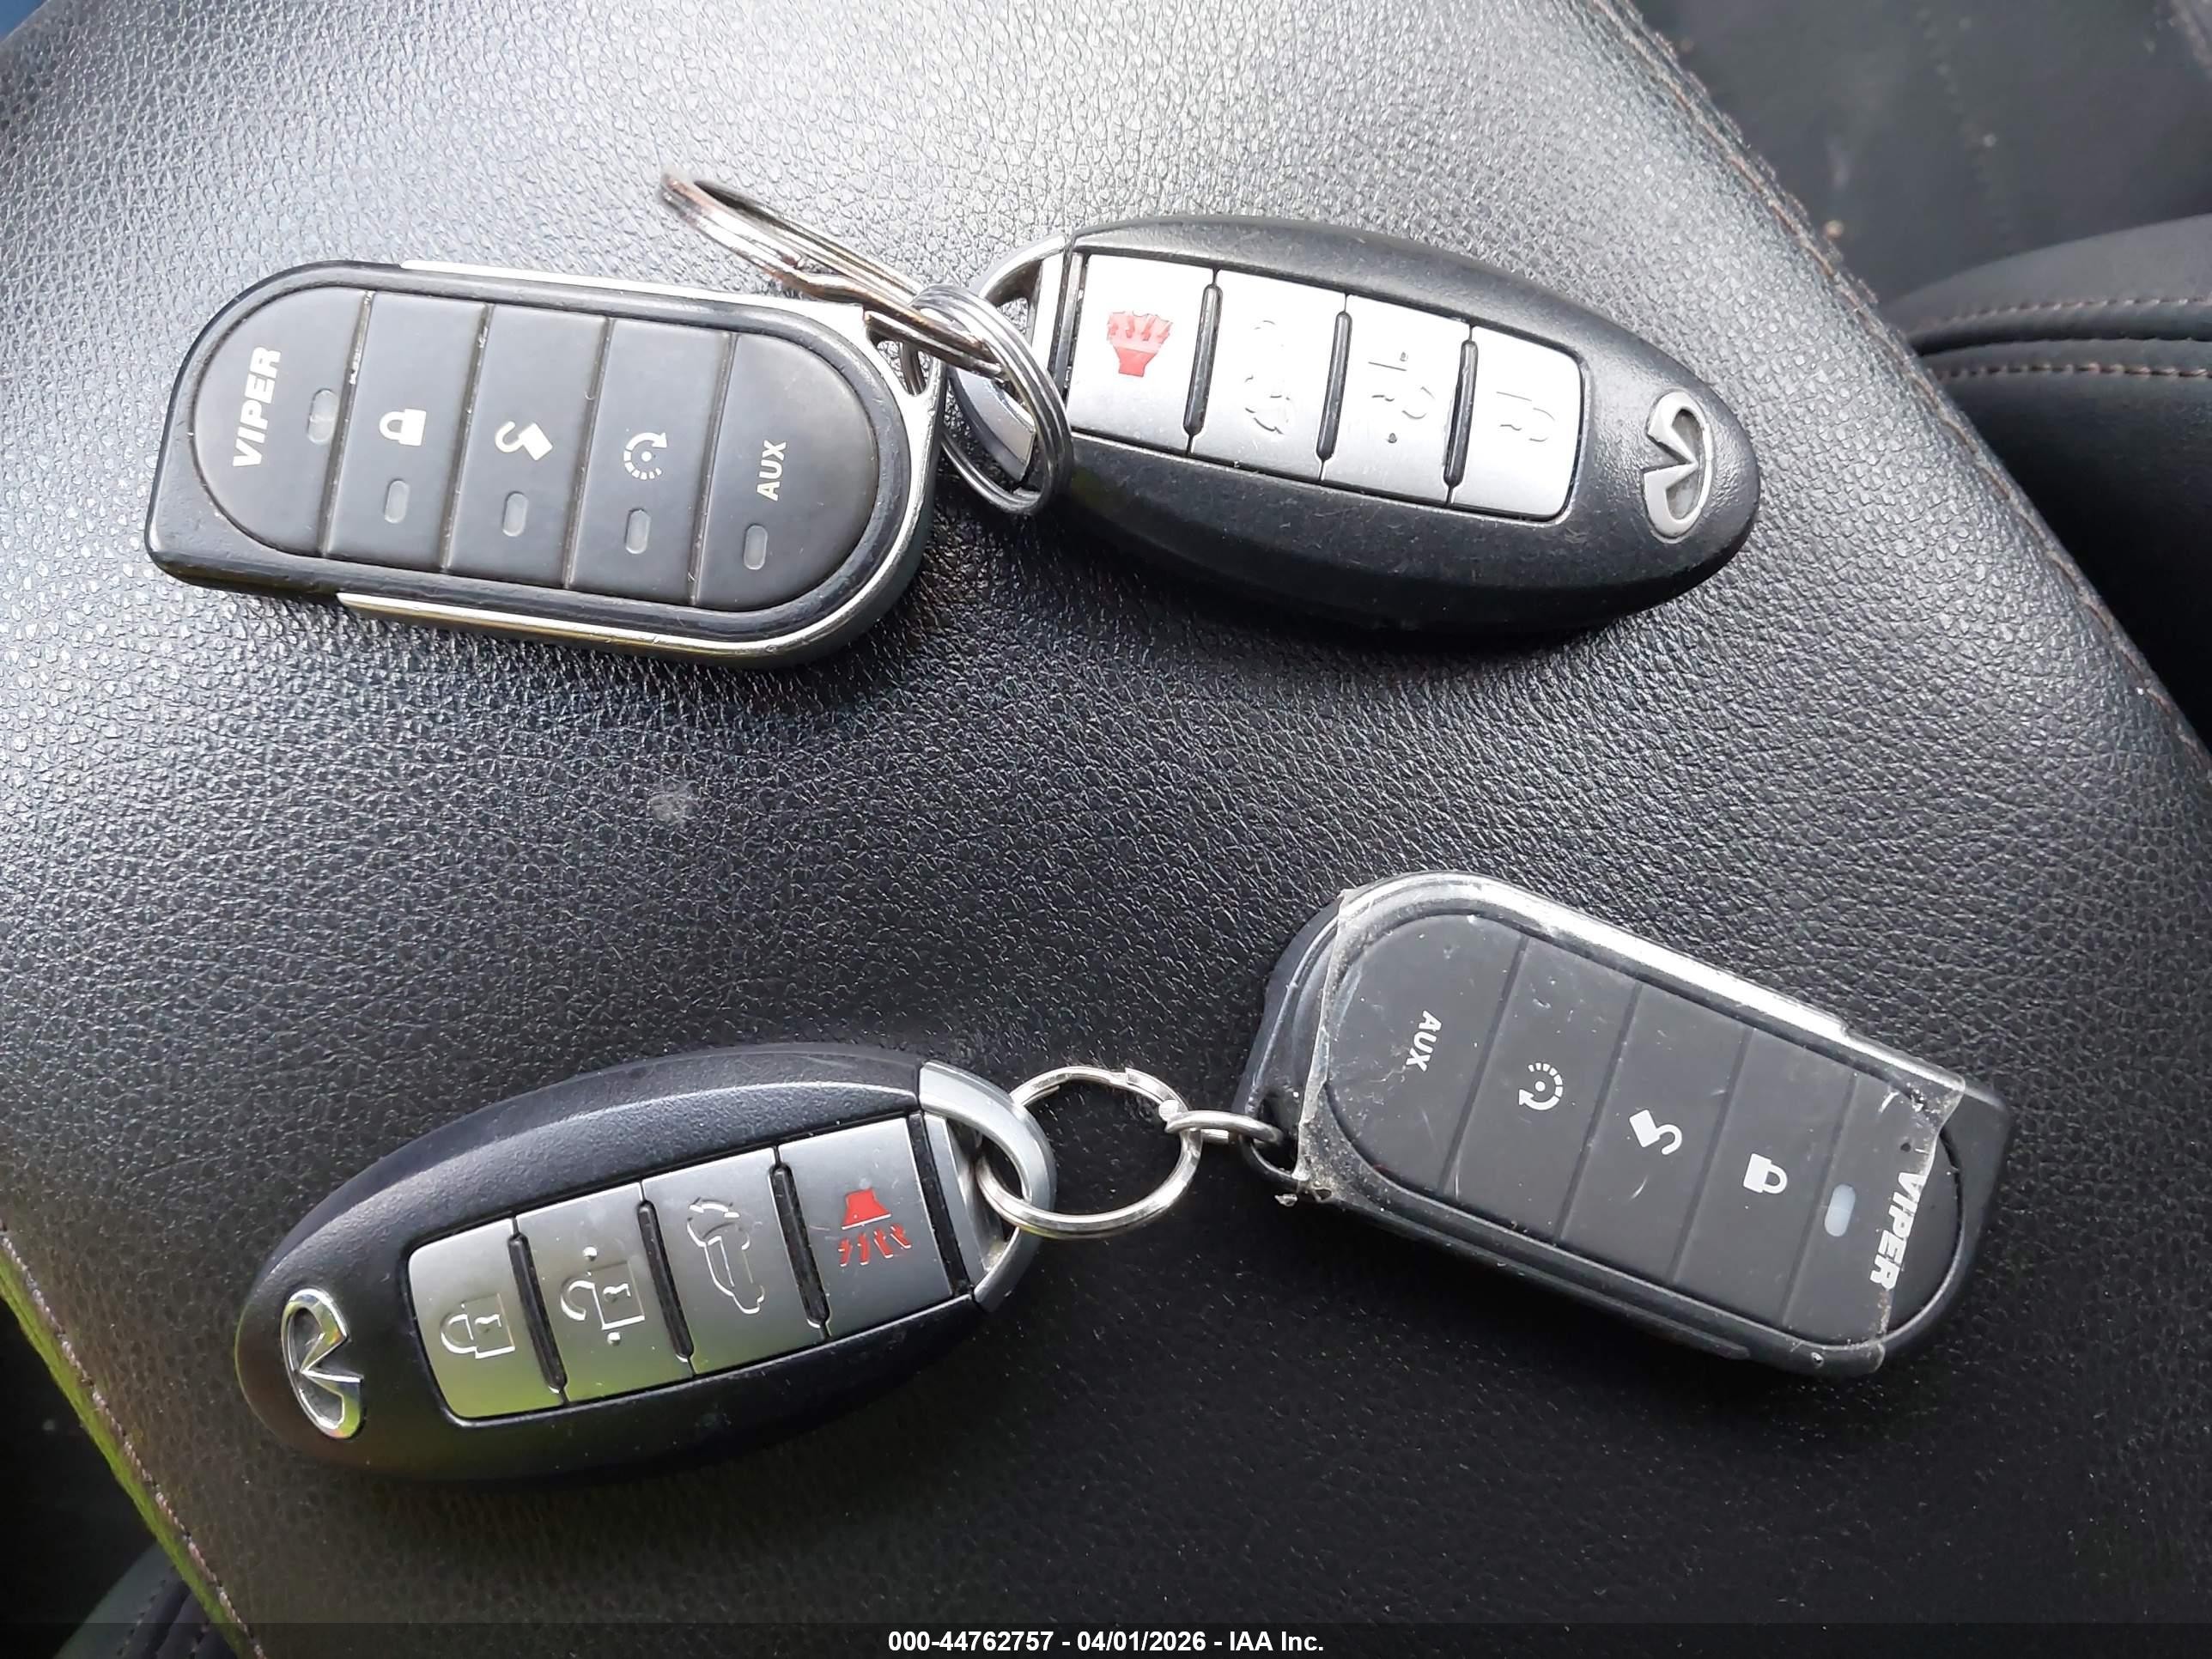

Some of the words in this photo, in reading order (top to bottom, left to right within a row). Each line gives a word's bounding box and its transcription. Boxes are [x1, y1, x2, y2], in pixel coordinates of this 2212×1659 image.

[233, 347, 282, 466] VIPER
[757, 439, 787, 501] AUX
[1406, 1010, 1443, 1072] AUX
[1869, 1172, 1928, 1290] VIPER
